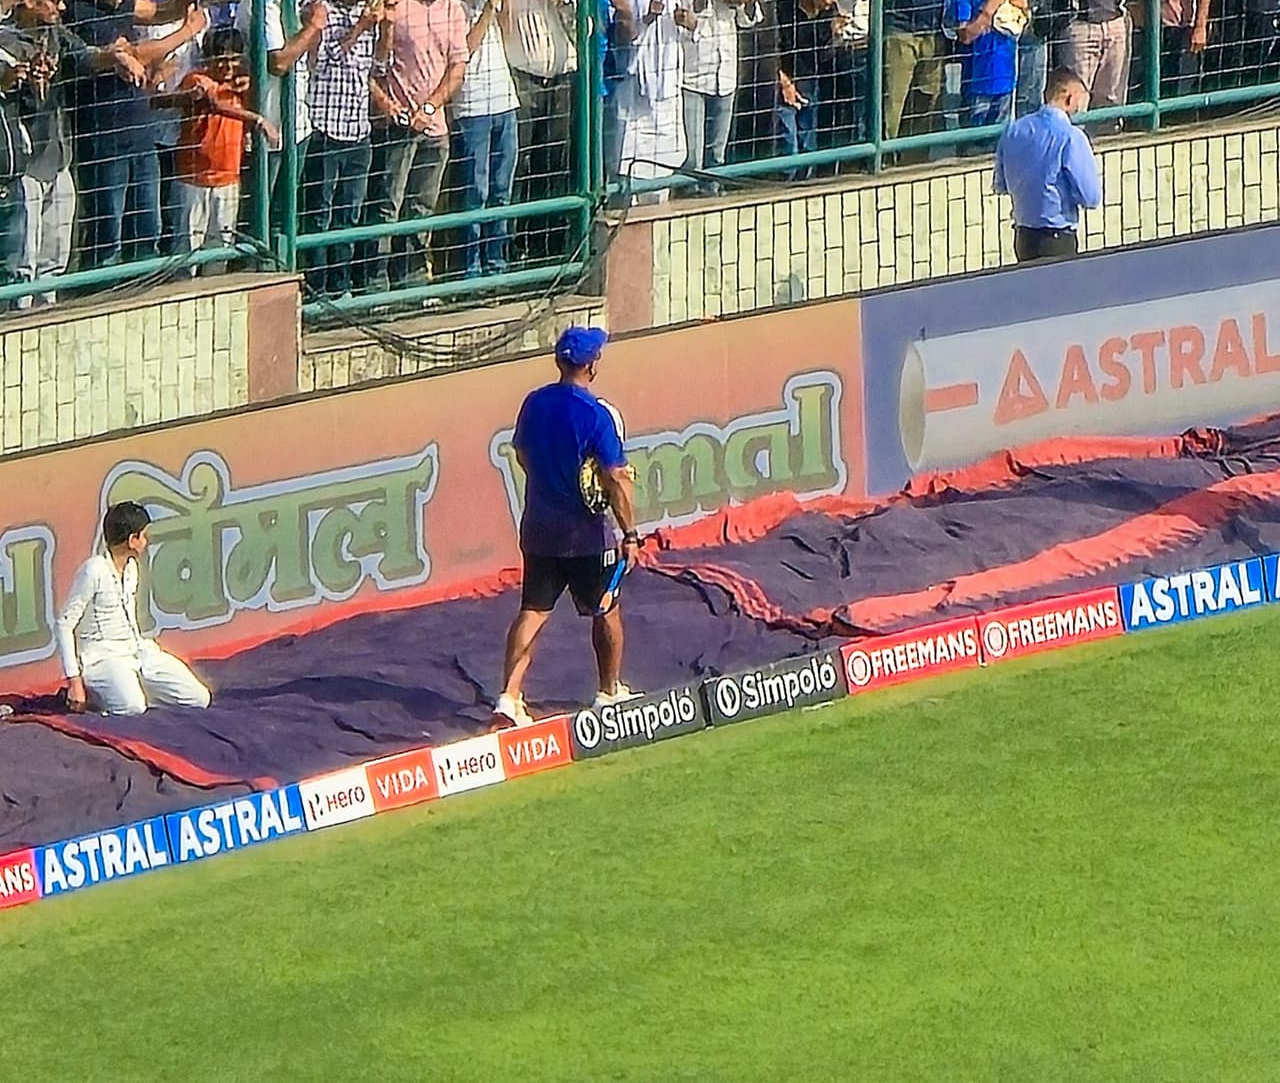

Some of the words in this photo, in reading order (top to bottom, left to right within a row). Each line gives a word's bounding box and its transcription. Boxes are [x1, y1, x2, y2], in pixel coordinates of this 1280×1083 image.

[1131, 564, 1261, 626] ASTRAL
[870, 629, 977, 678] FREEMANS
[1008, 601, 1117, 649] FREEMANS
[327, 785, 366, 812] Hero
[376, 765, 430, 798] VIDA
[457, 752, 497, 778] Hero
[508, 733, 560, 766] VIDA
[44, 823, 168, 894] ASTRAL
[180, 789, 300, 861] ASTRAL
